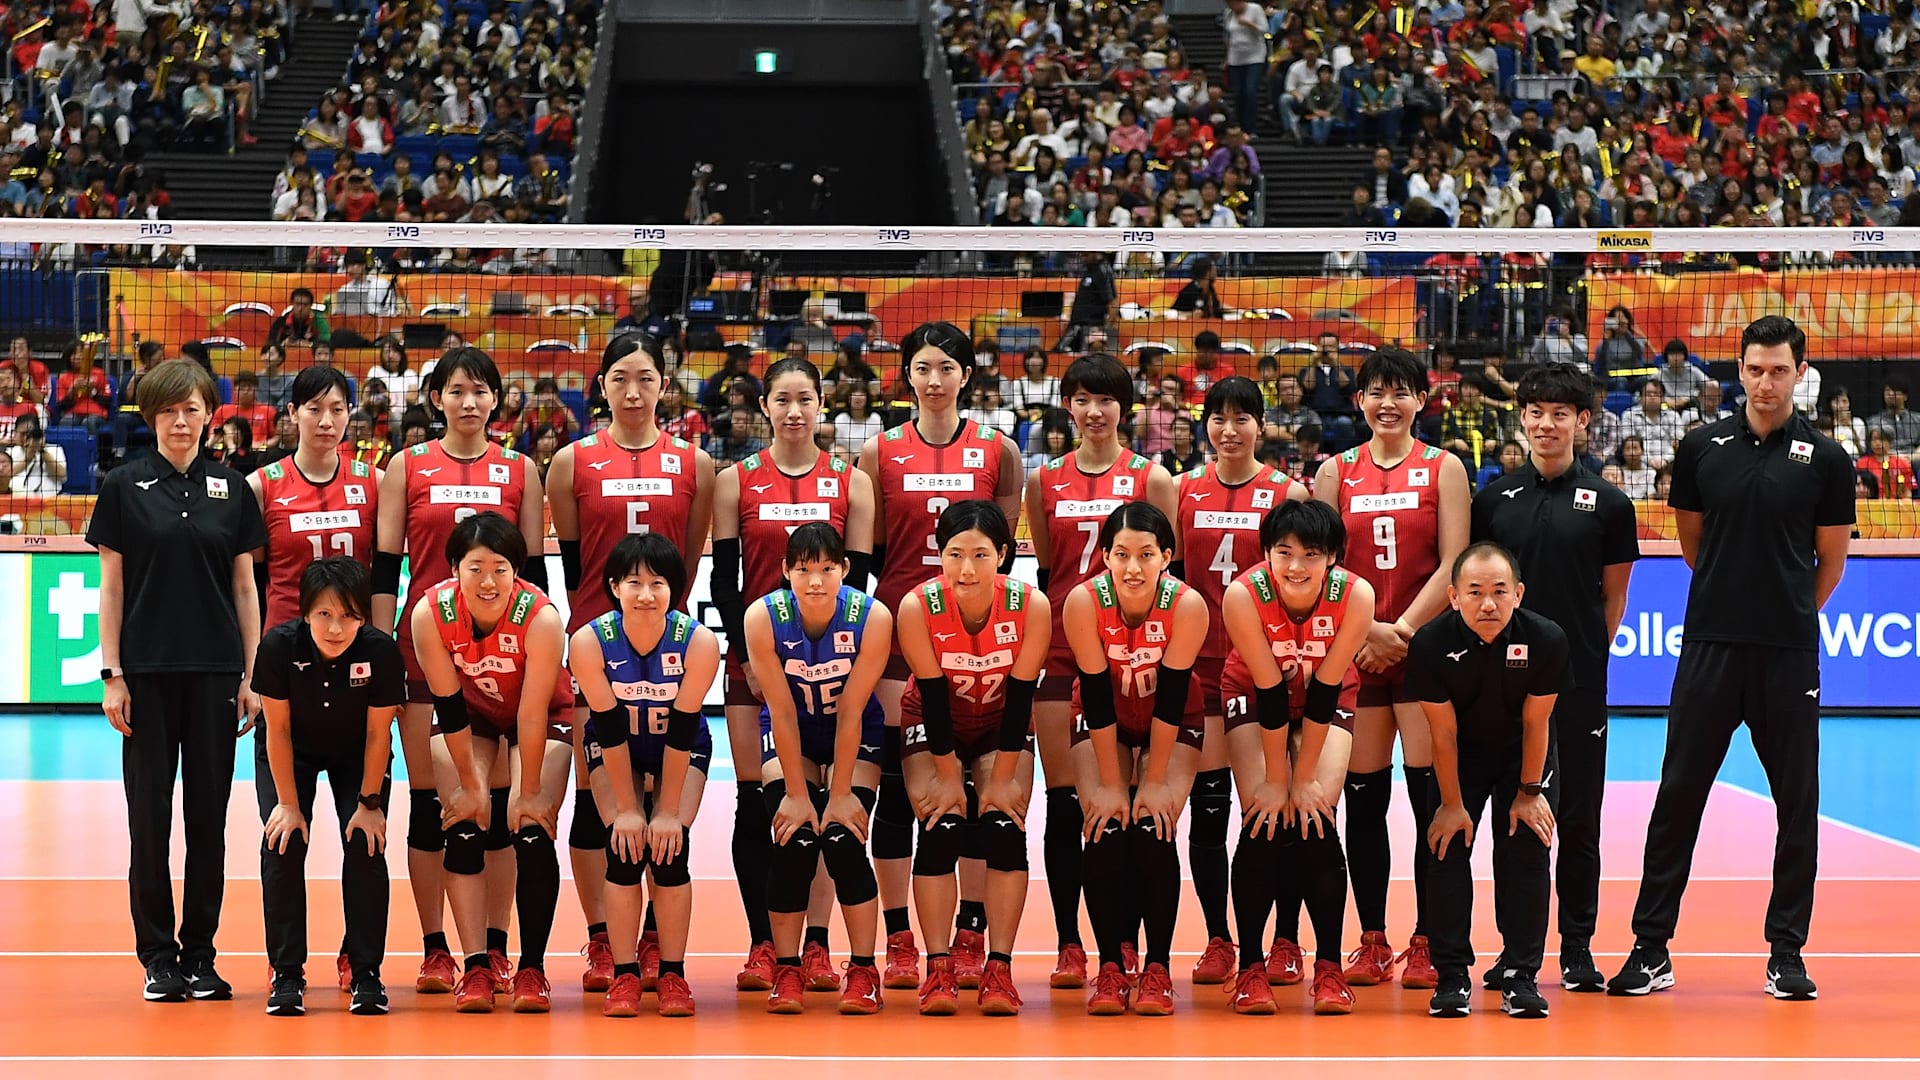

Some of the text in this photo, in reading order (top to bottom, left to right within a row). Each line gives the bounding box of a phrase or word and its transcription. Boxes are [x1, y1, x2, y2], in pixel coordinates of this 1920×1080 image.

[140, 223, 172, 234] FIVB
[387, 226, 420, 237] FIVB
[634, 228, 665, 239] FIVB
[879, 229, 910, 240] FIVB
[1123, 231, 1154, 242] FIVB
[1365, 231, 1397, 242] FIVB
[1852, 230, 1884, 241] FIVB
[1077, 521, 1099, 575] 7
[1372, 516, 1397, 570] 9
[1208, 533, 1238, 586] 4
[511, 592, 533, 624] サロンパス
[1817, 612, 1920, 658] WC
[806, 664, 840, 678] 日本生命
[967, 655, 1001, 668] 日本生命
[636, 685, 667, 697] 日本生命
[951, 673, 1005, 705] 22
[1119, 664, 1158, 698] 10
[796, 681, 842, 716] 15
[1226, 695, 1247, 719] 21
[623, 704, 670, 736] 16
[905, 723, 928, 746] 22
